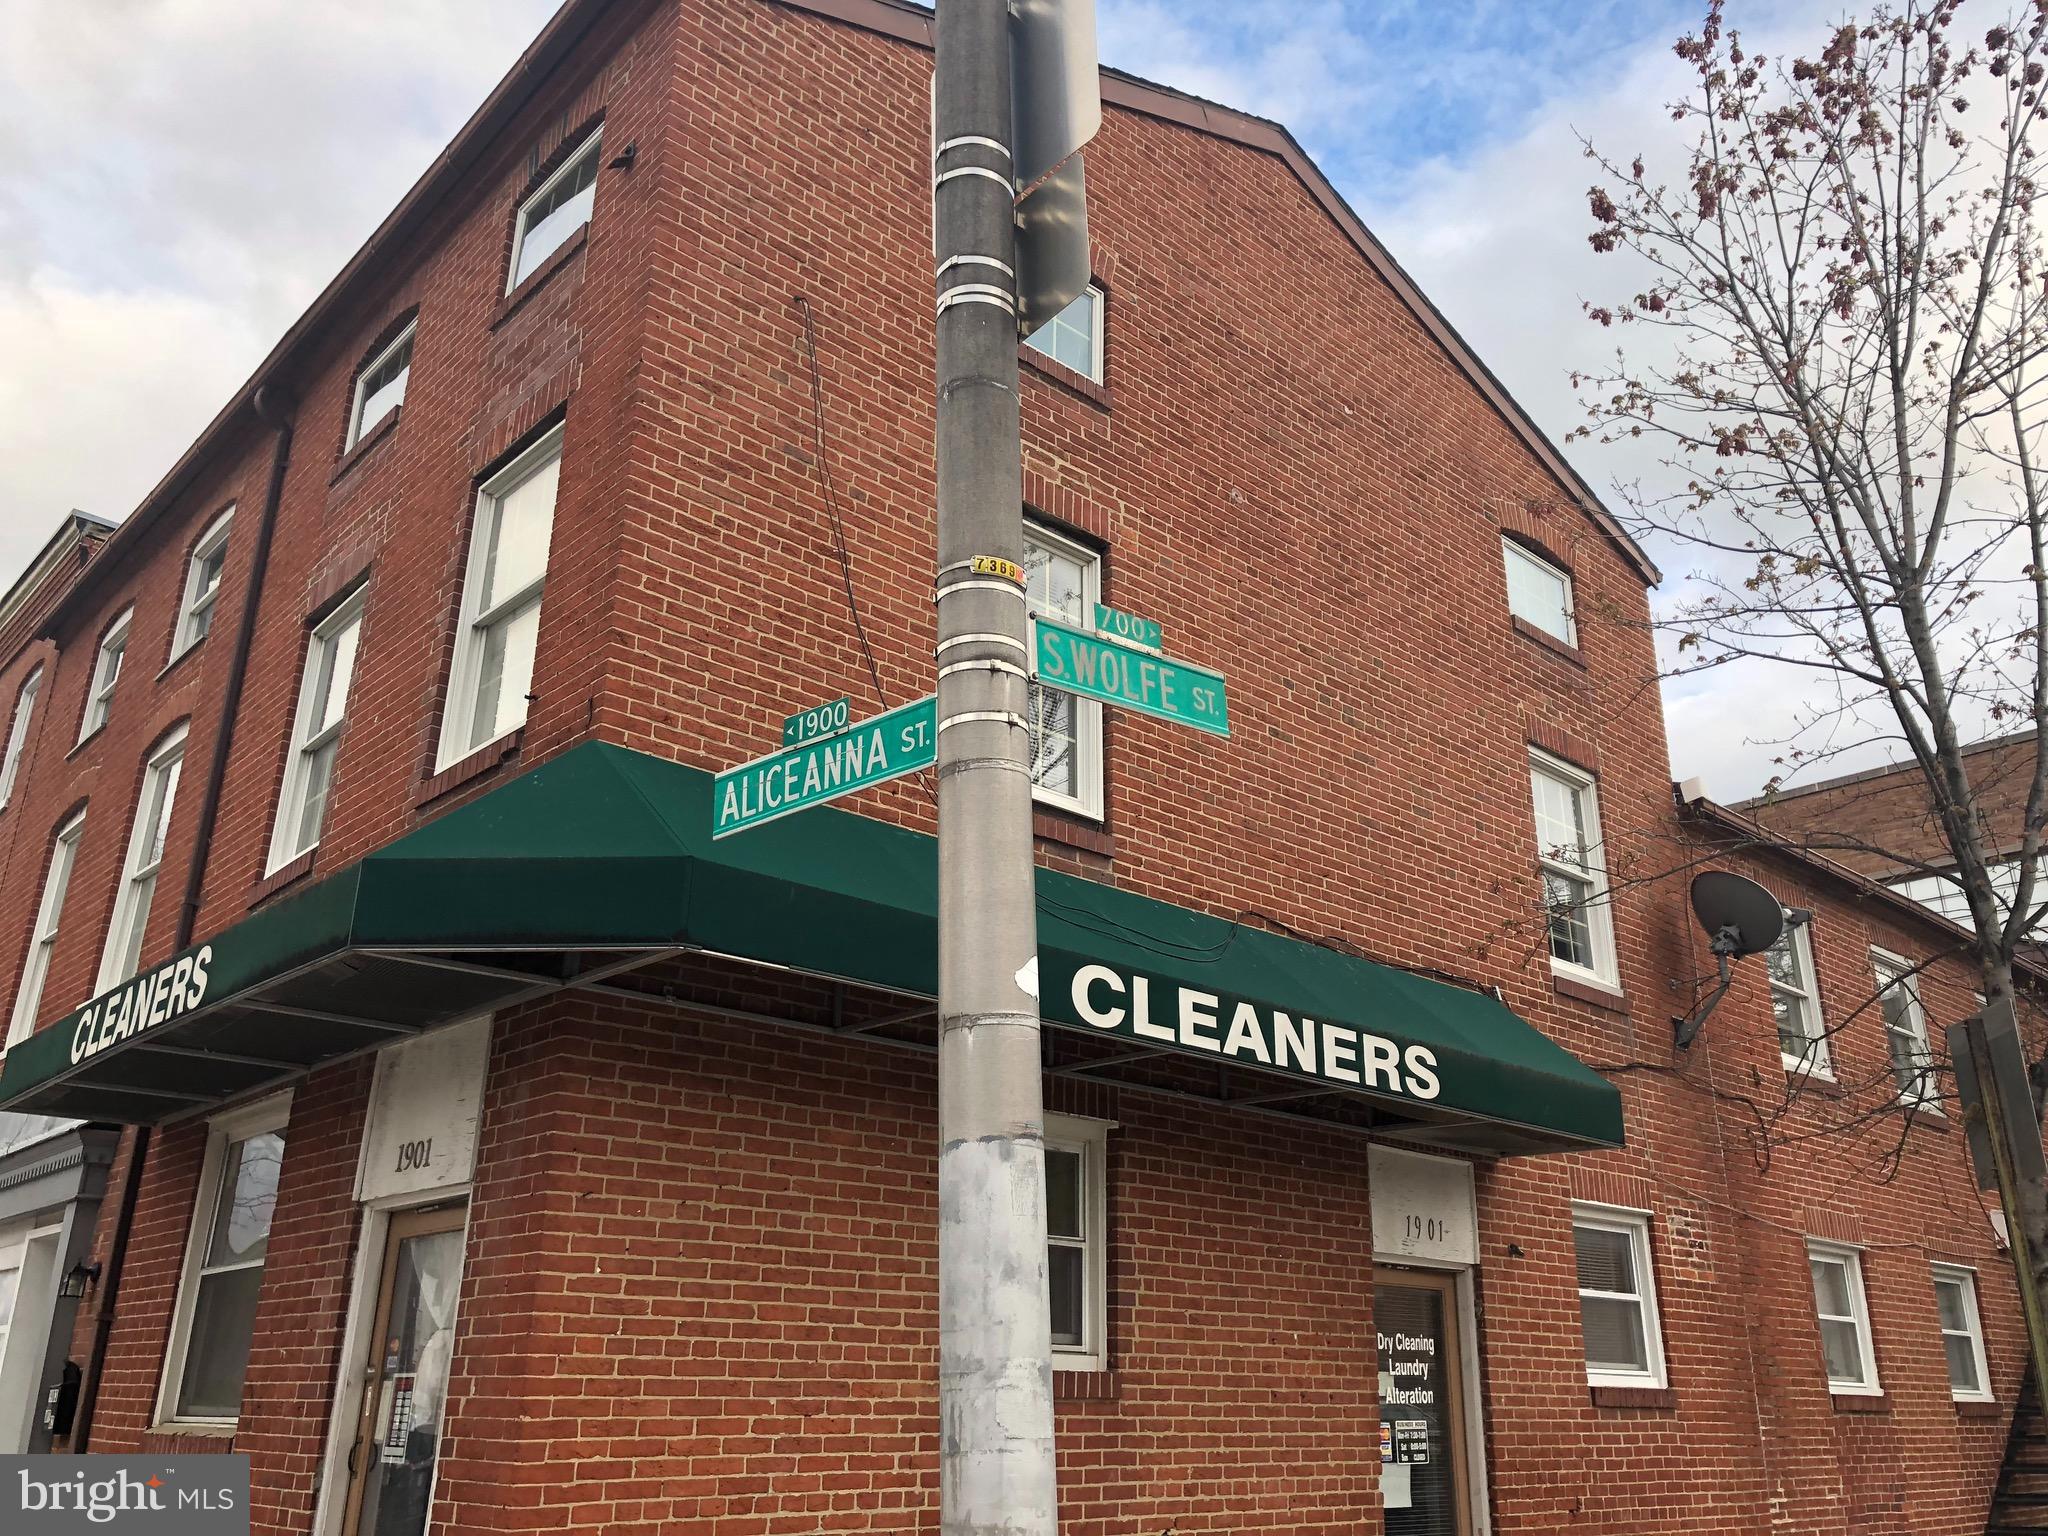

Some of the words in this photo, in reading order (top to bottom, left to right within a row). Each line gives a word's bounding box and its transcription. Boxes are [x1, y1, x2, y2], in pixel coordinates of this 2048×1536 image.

[1100, 607, 1145, 640] 700
[1192, 686, 1220, 716] ST.
[798, 701, 848, 740] 1900
[720, 727, 888, 826] ALICEANNA
[901, 720, 930, 753] ST.
[71, 945, 213, 1065] CLEANERS
[1071, 964, 1441, 1100] CLEANERS
[394, 1138, 432, 1173] 1901
[1406, 1215, 1443, 1242] 1901
[1377, 1332, 1394, 1355] Dry
[1395, 1332, 1435, 1356] Cleaning
[1388, 1358, 1429, 1381] Laundry
[1385, 1386, 1434, 1405] Alteration
